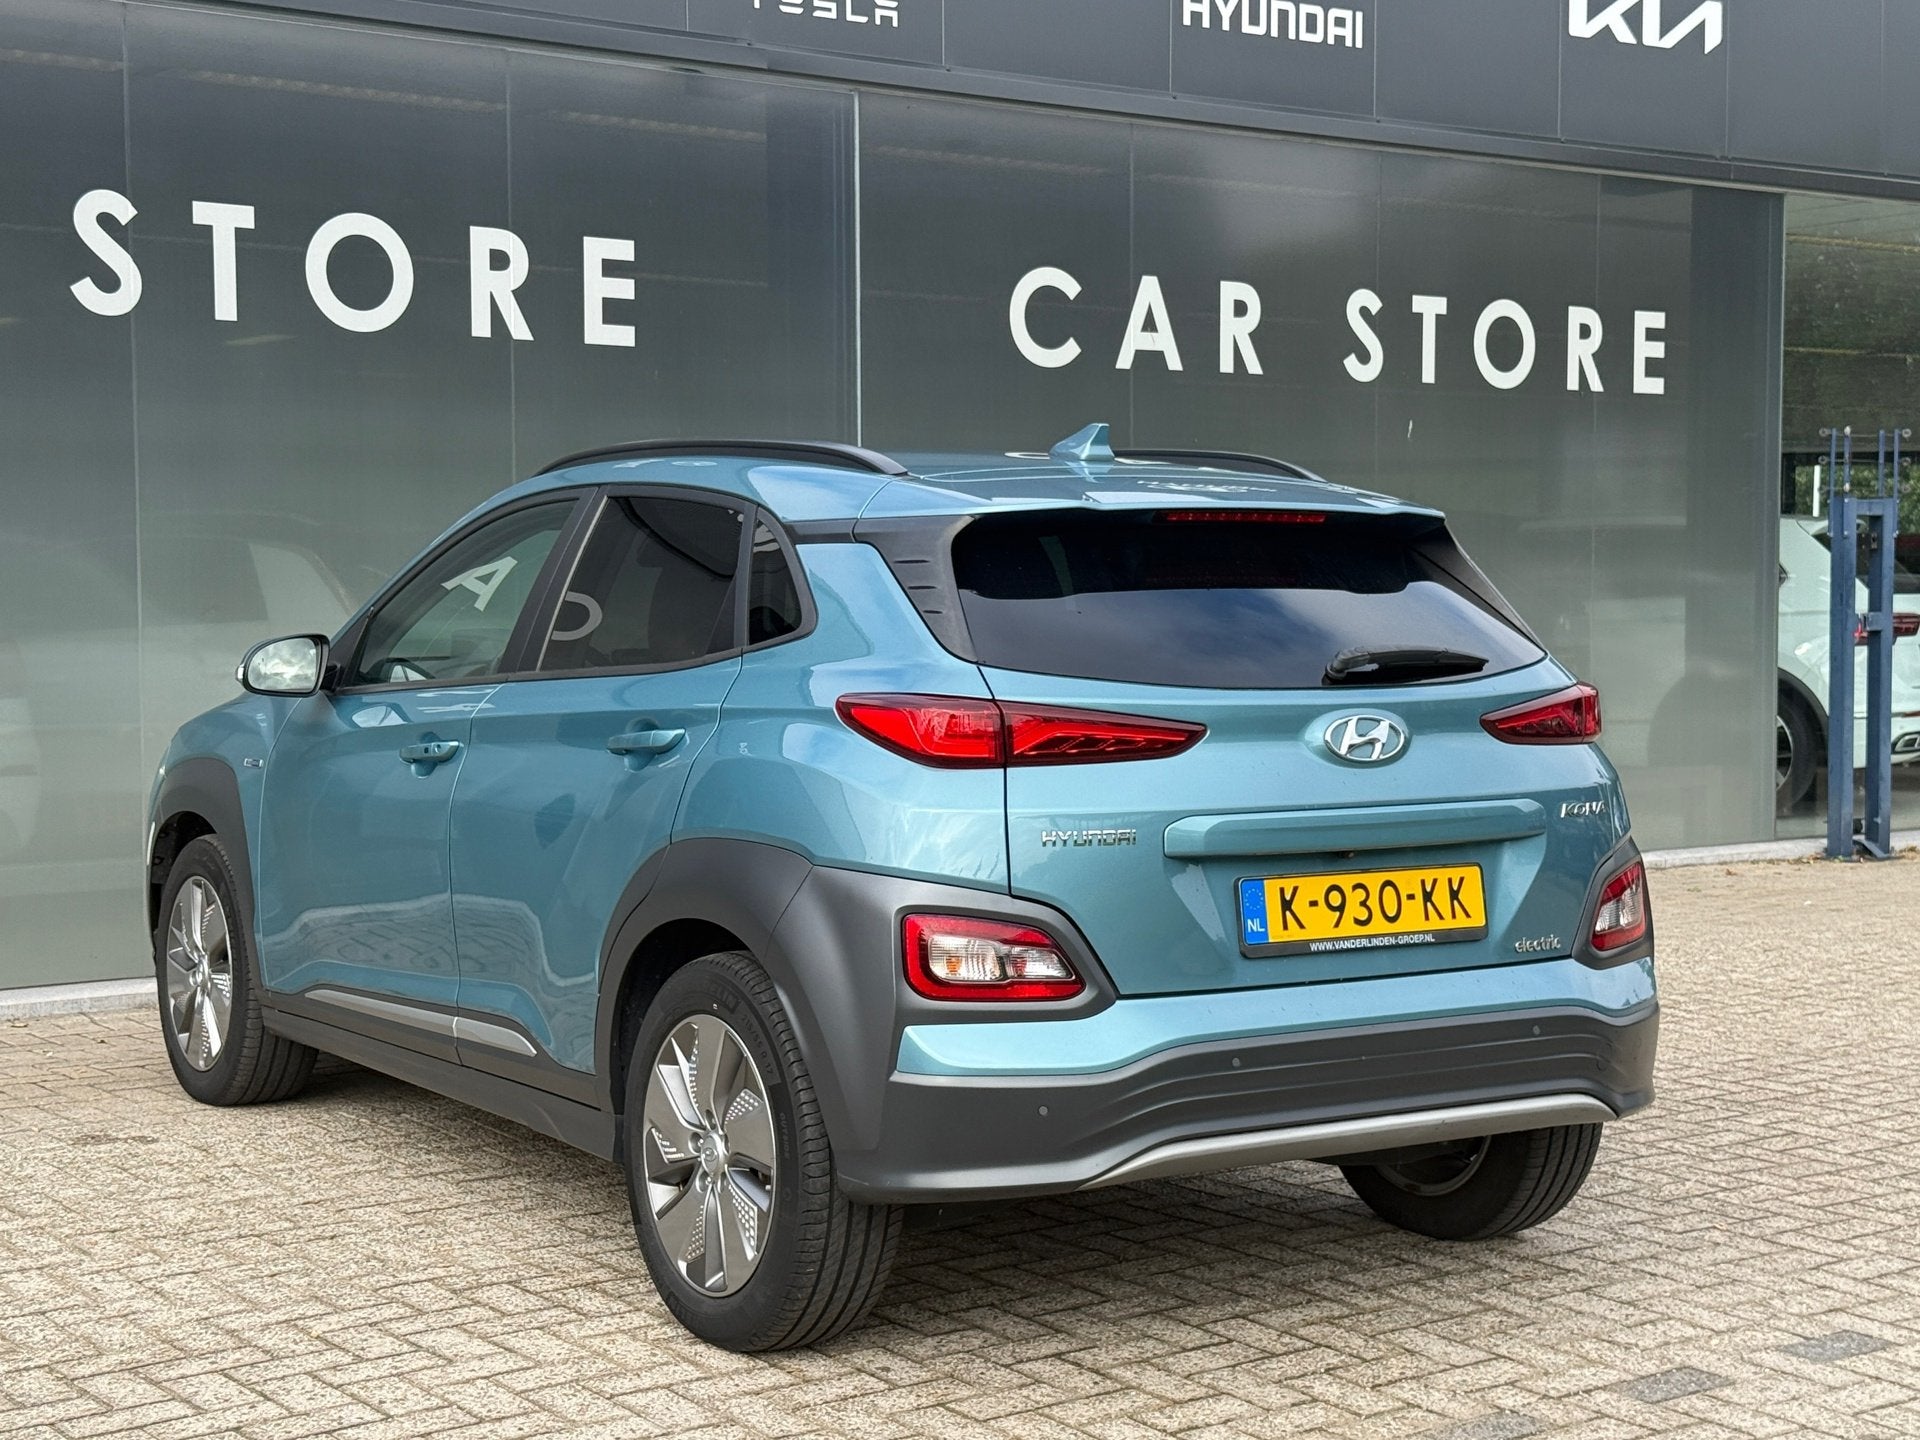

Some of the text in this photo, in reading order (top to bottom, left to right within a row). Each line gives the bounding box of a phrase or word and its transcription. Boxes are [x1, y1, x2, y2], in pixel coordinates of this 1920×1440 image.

[753, 0, 899, 28] ESLA
[1182, 0, 1364, 49] HYUNDAI
[1568, 0, 1723, 55] KIA
[69, 189, 636, 347] STORE
[1009, 266, 1666, 395] CAR STORE
[1041, 829, 1137, 847] HYUNDAI
[1279, 876, 1472, 931] K-930-KK
[1247, 917, 1266, 933] NL
[1309, 933, 1436, 952] WWW.VANDERLINDEN-GROEP.NL
[1514, 933, 1561, 953] electric
